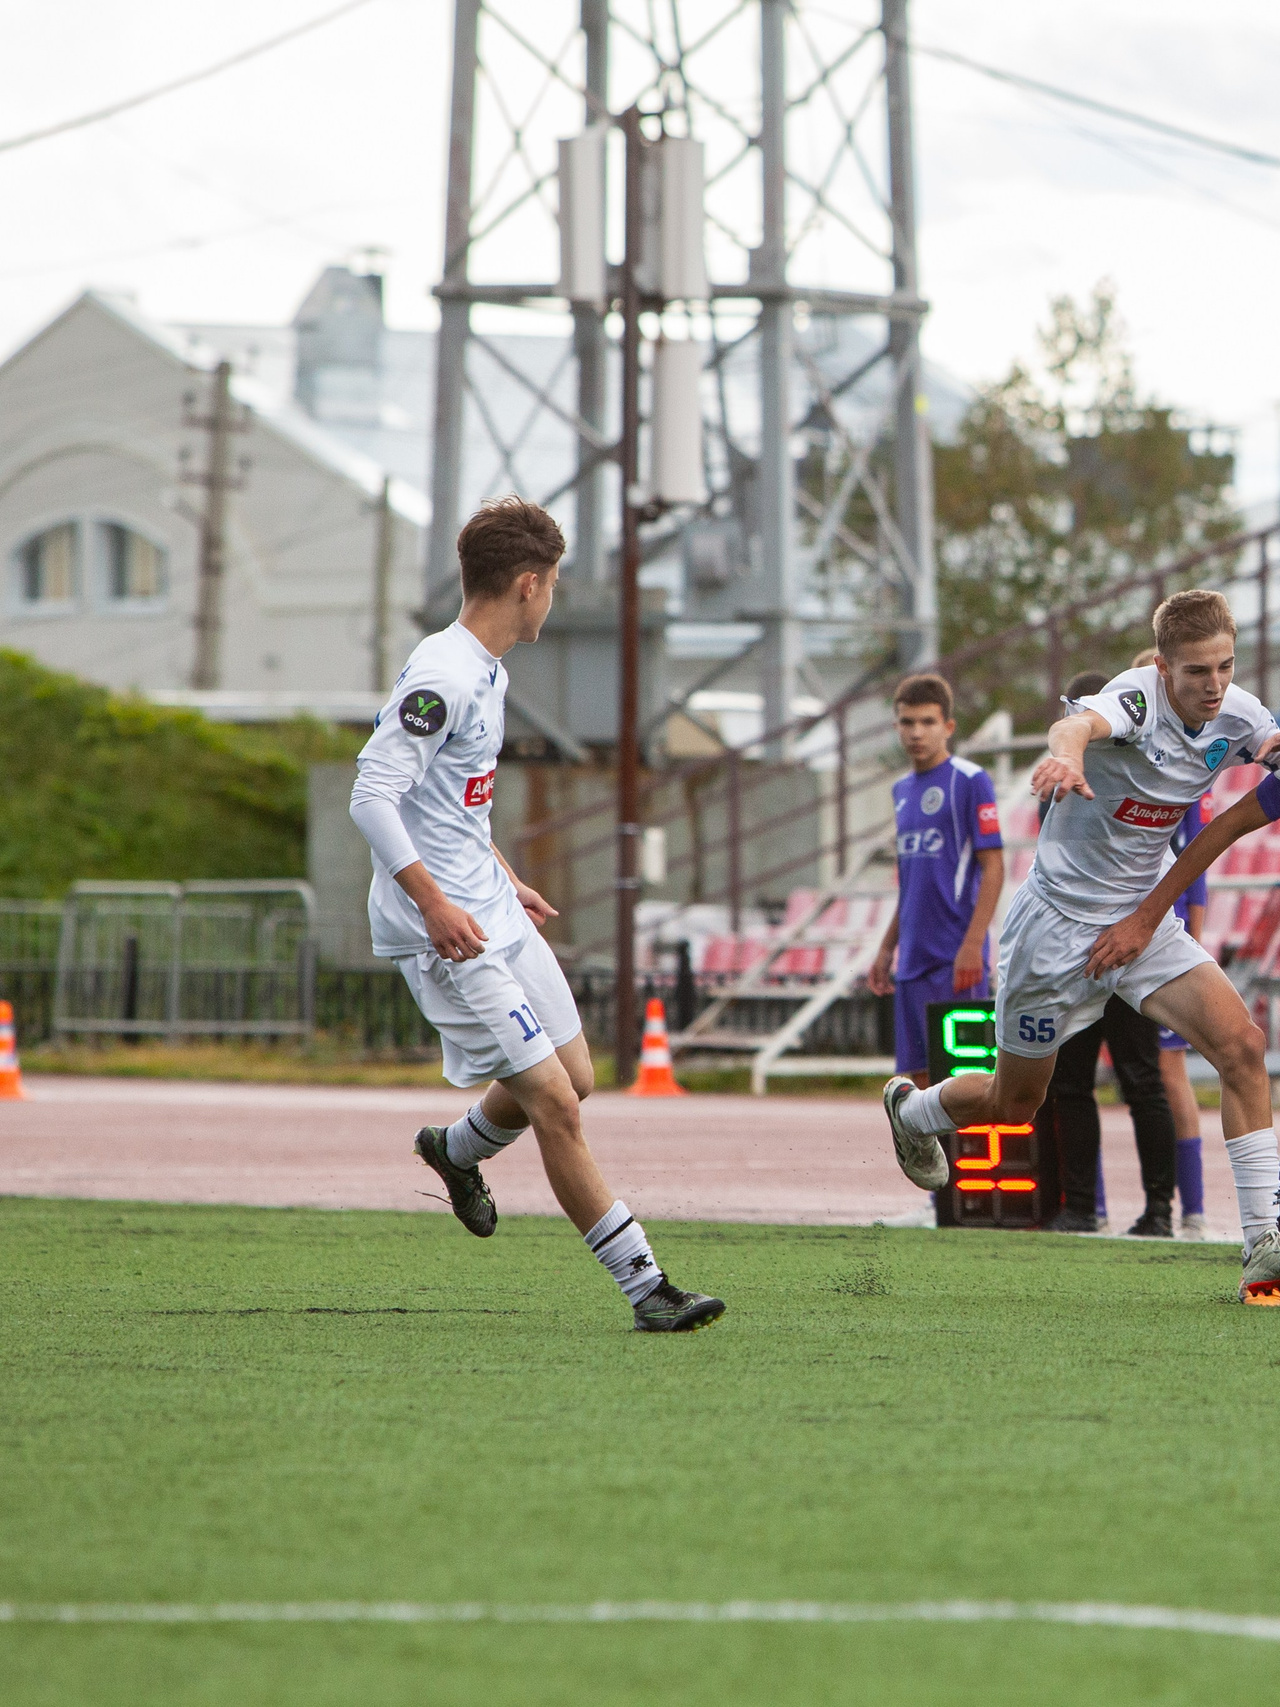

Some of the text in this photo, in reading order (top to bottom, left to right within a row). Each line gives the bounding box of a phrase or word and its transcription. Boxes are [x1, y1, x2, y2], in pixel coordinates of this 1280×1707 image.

[1122, 696, 1141, 719] ЮФЛ
[404, 712, 430, 731] ЮФЛ
[1123, 804, 1186, 822] Альфа Ба
[508, 1003, 542, 1042] 11
[1018, 1014, 1056, 1043] 55
